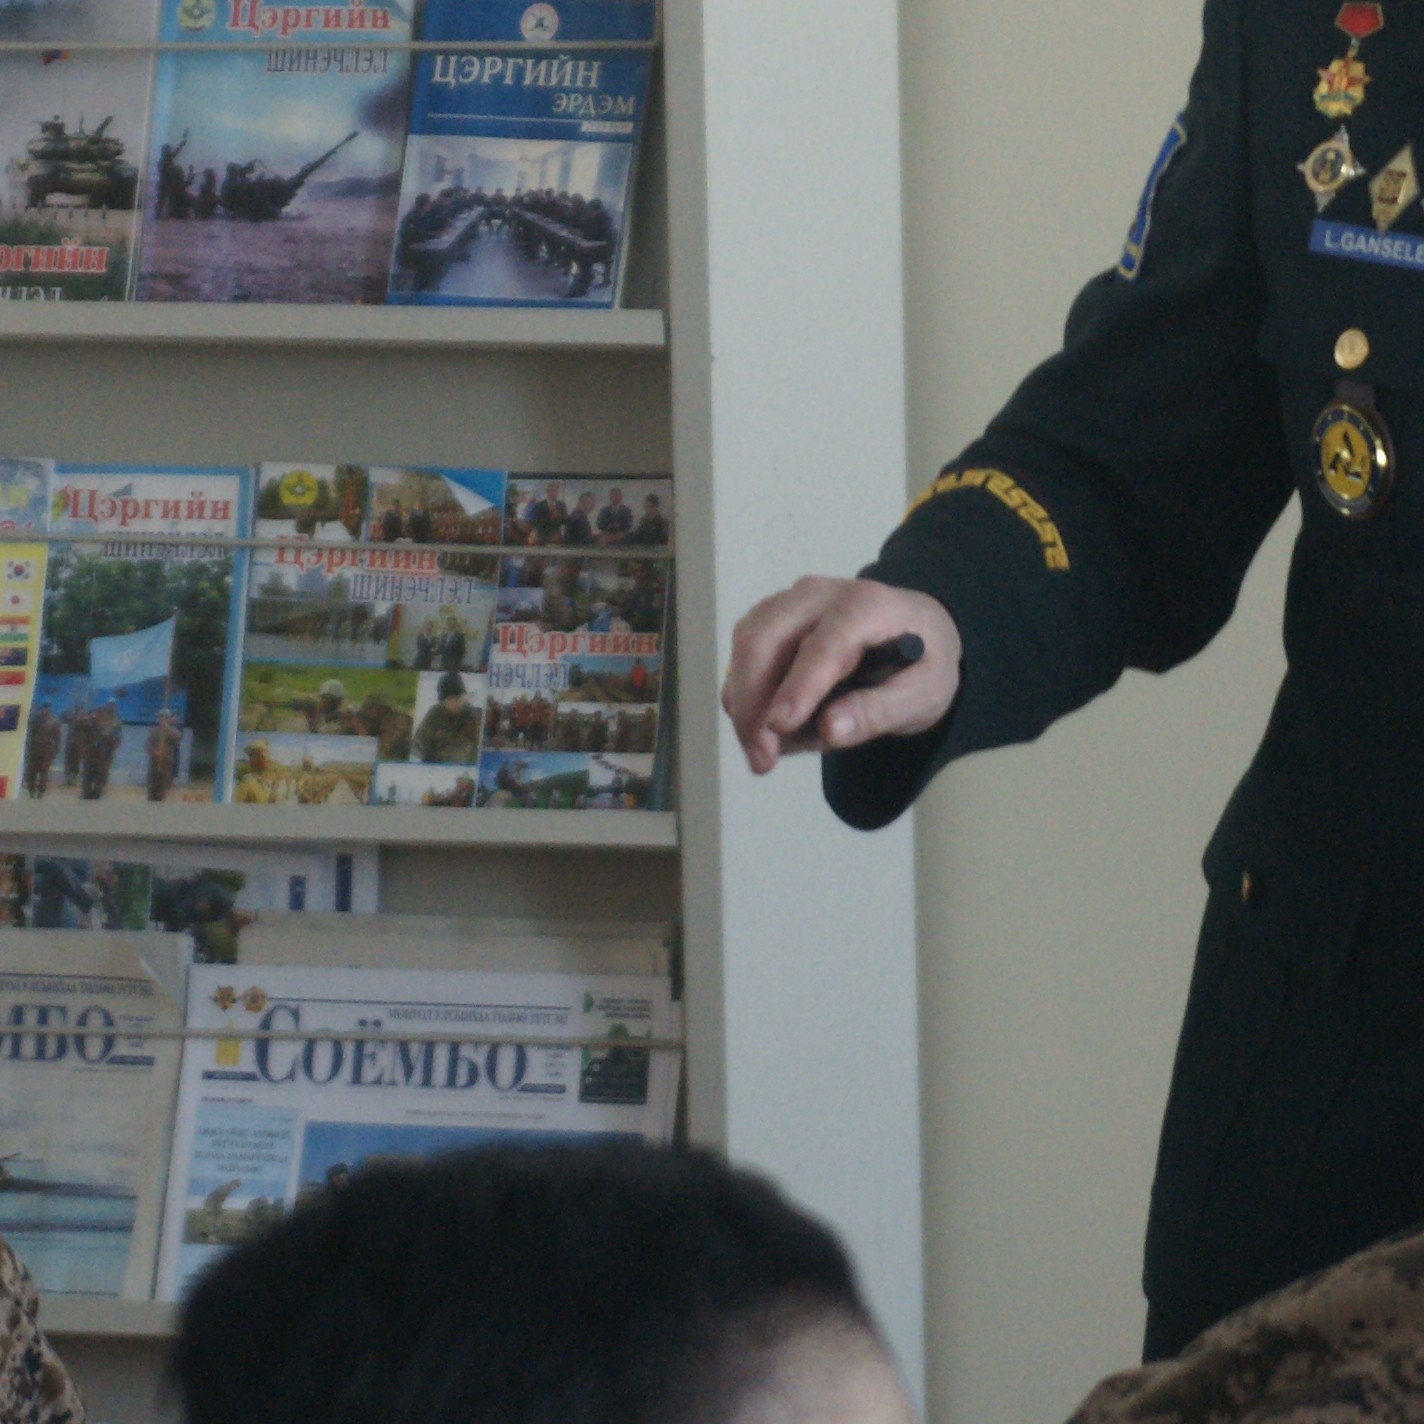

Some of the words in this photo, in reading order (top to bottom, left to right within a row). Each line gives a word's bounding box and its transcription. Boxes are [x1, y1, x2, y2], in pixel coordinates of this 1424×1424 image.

[432, 54, 602, 89] ЦЭРГИЙН
[552, 93, 636, 117] ЭРДЭМ
[69, 488, 232, 526] Цэргийн
[497, 622, 658, 660] Цэргийн
